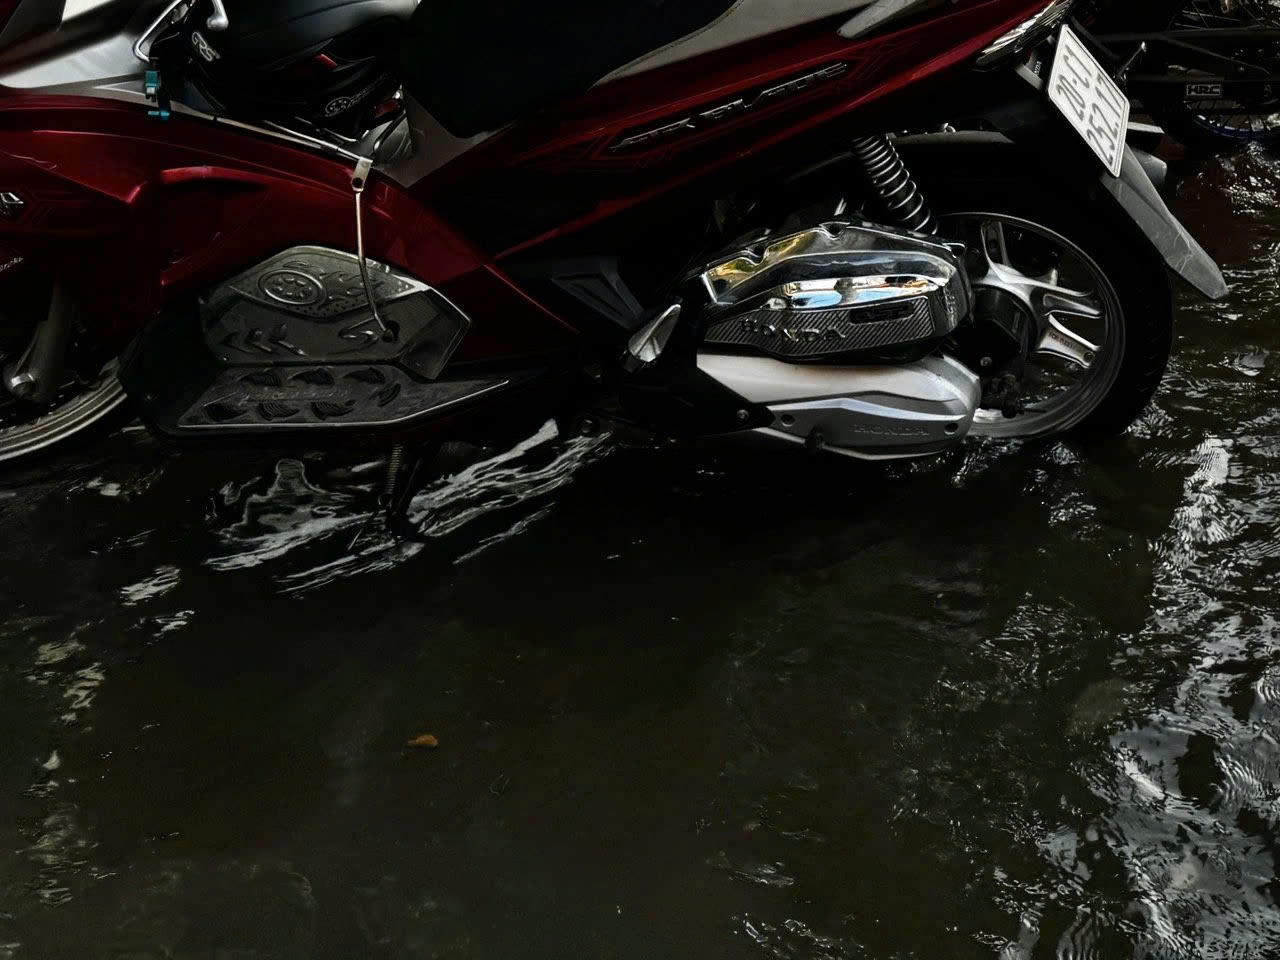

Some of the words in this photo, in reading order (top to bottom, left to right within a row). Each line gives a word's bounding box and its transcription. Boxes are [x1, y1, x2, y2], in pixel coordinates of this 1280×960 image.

[1187, 85, 1220, 95] HRC
[1087, 74, 1122, 167] 252.17
[741, 318, 846, 342] HONDA
